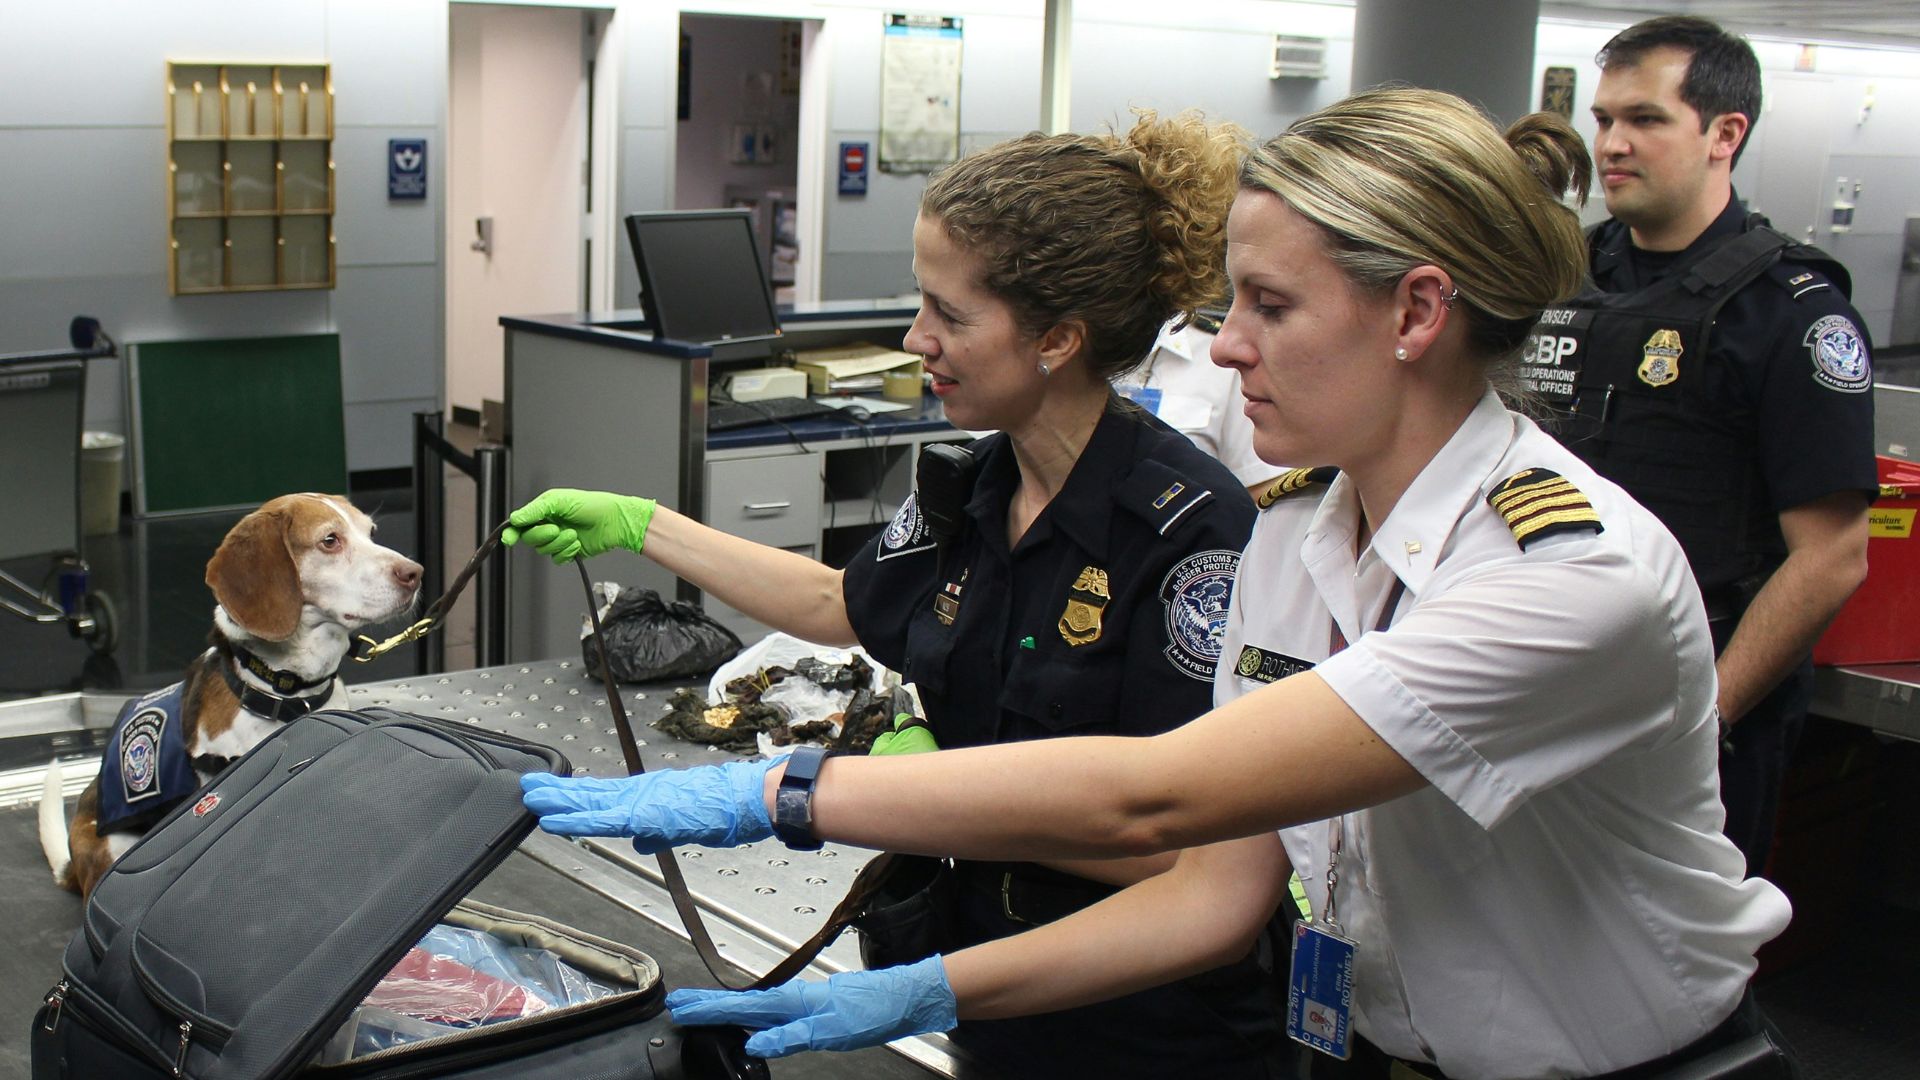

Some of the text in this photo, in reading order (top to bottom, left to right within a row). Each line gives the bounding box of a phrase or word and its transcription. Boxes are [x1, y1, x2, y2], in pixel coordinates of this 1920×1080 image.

[1541, 309, 1577, 325] ENSLEY
[1522, 334, 1577, 365] CBP
[1531, 368, 1576, 382] OPERATIONS
[1541, 381, 1574, 395] OFFICER
[1868, 514, 1901, 524] riculture
[1173, 562, 1238, 591] BORDER PROTEC
[1176, 565, 1191, 578] U.S.
[1192, 555, 1232, 567] CUSTOMS
[1190, 661, 1213, 674] FIELD
[1261, 656, 1306, 676] ROTHN
[1341, 951, 1353, 1008] ROTHNEY
[1292, 985, 1300, 1009] 2017
